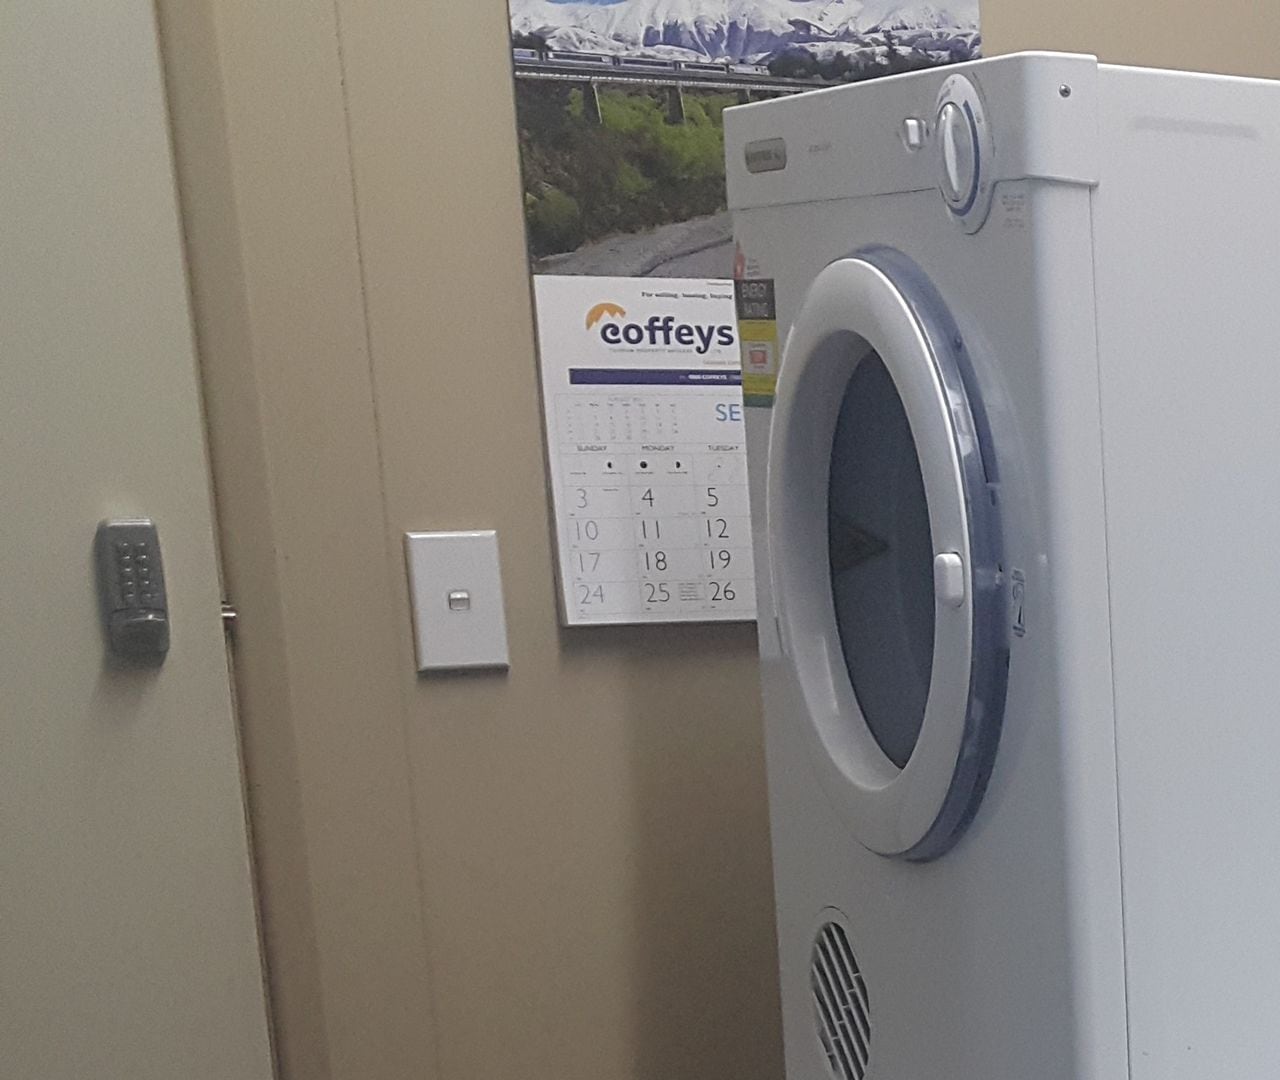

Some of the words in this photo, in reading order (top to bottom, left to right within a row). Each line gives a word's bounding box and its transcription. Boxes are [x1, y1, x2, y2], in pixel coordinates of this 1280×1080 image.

[600, 316, 734, 354] coffeys
[576, 488, 588, 509] 3
[641, 488, 655, 508] 4
[707, 487, 719, 507] 5
[576, 520, 599, 541] 10
[642, 520, 660, 539] 11
[707, 518, 730, 539] 12
[579, 552, 600, 573] 17
[645, 551, 668, 571] 18
[710, 549, 731, 570] 19
[580, 584, 604, 605] 24
[645, 582, 671, 603] 25
[709, 581, 736, 602] 26
